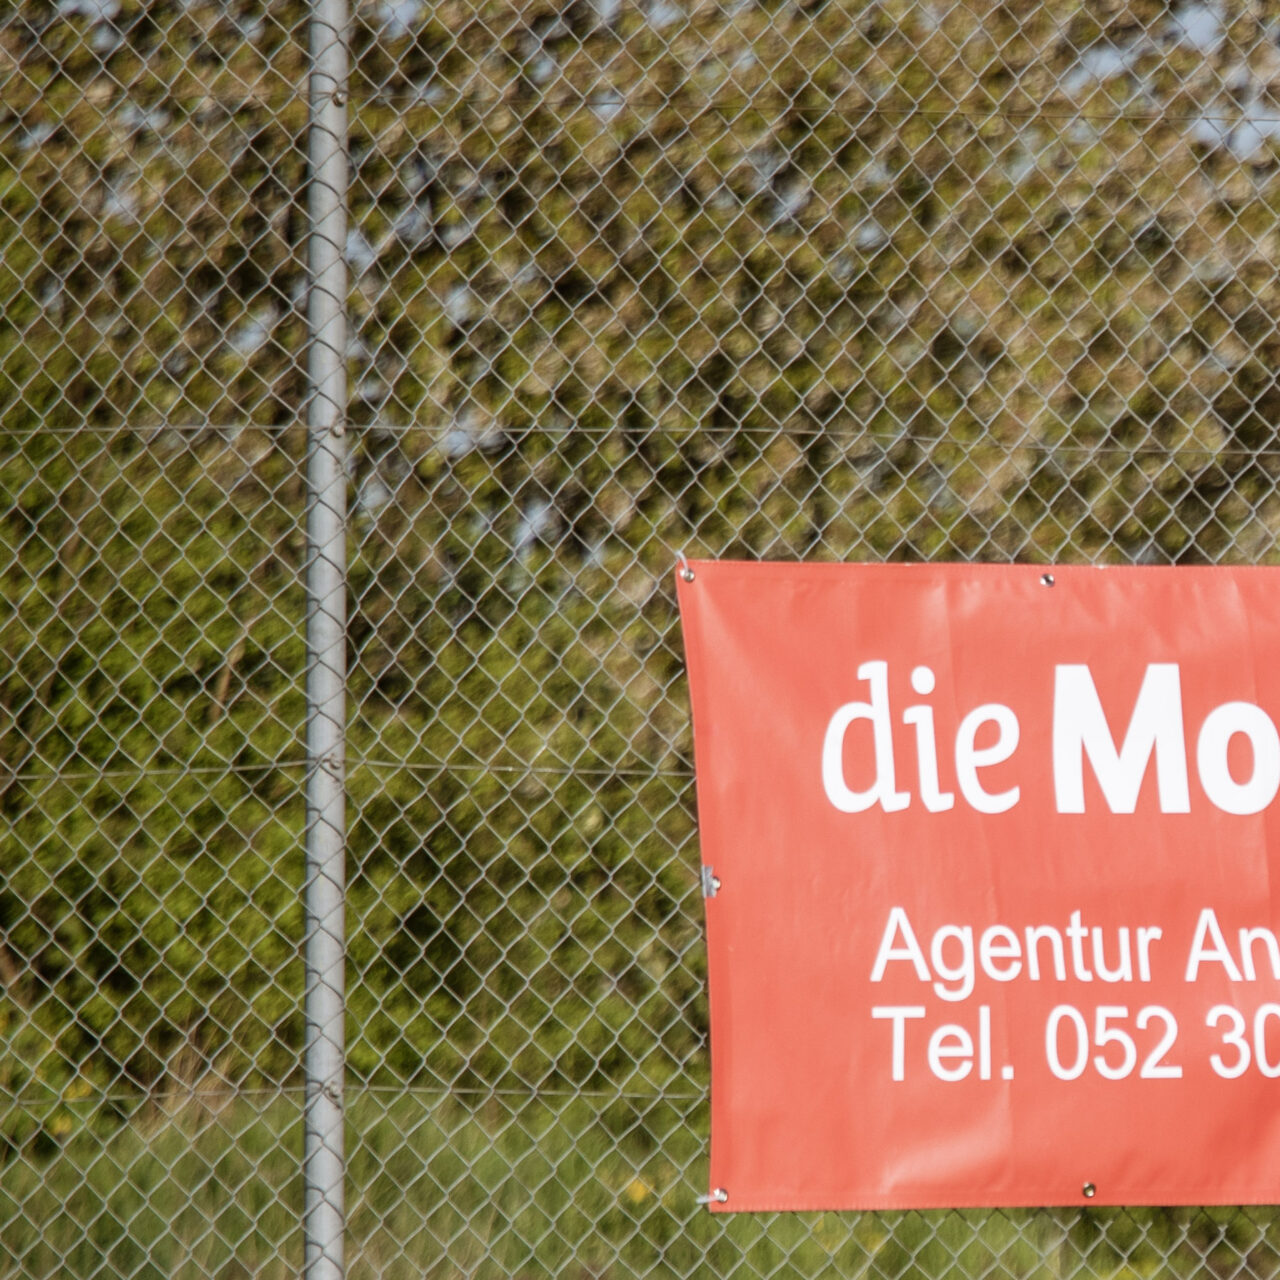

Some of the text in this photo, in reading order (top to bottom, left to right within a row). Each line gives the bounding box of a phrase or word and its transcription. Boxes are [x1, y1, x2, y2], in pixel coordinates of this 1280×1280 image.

[821, 659, 1022, 816] die
[869, 906, 1163, 1003] Agentur
[871, 1004, 1014, 1082] Tel.
[1045, 1004, 1183, 1082] 052
